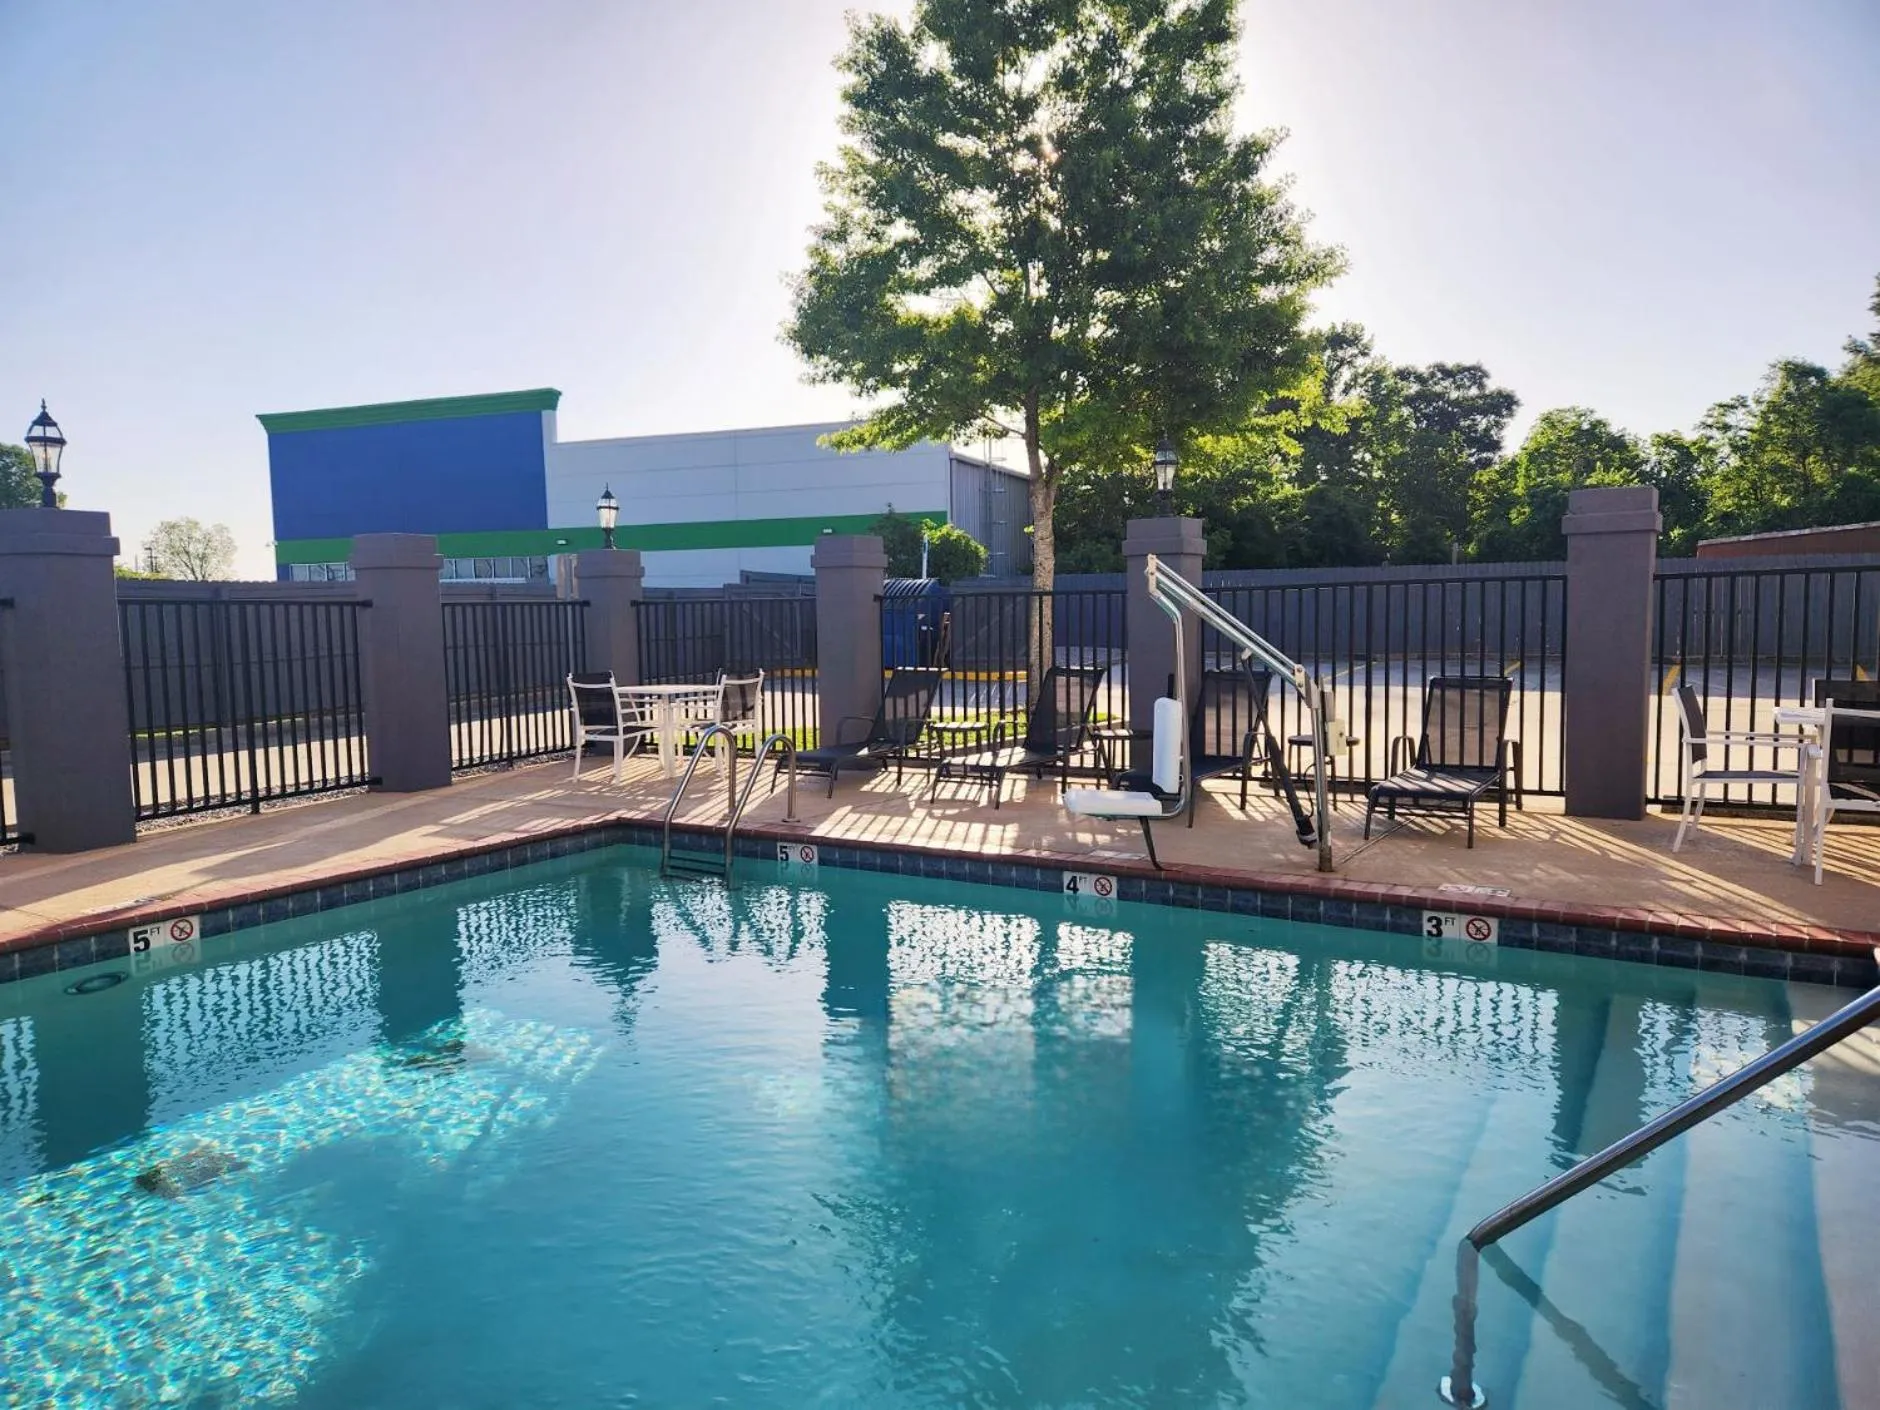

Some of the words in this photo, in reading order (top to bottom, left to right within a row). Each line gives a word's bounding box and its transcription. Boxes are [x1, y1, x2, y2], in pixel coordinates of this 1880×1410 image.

[779, 845, 789, 861] 5
[1066, 875, 1080, 894] 4
[1426, 916, 1443, 938] 3
[1444, 916, 1456, 926] FT
[133, 929, 150, 952] 5
[150, 926, 161, 936] FT
